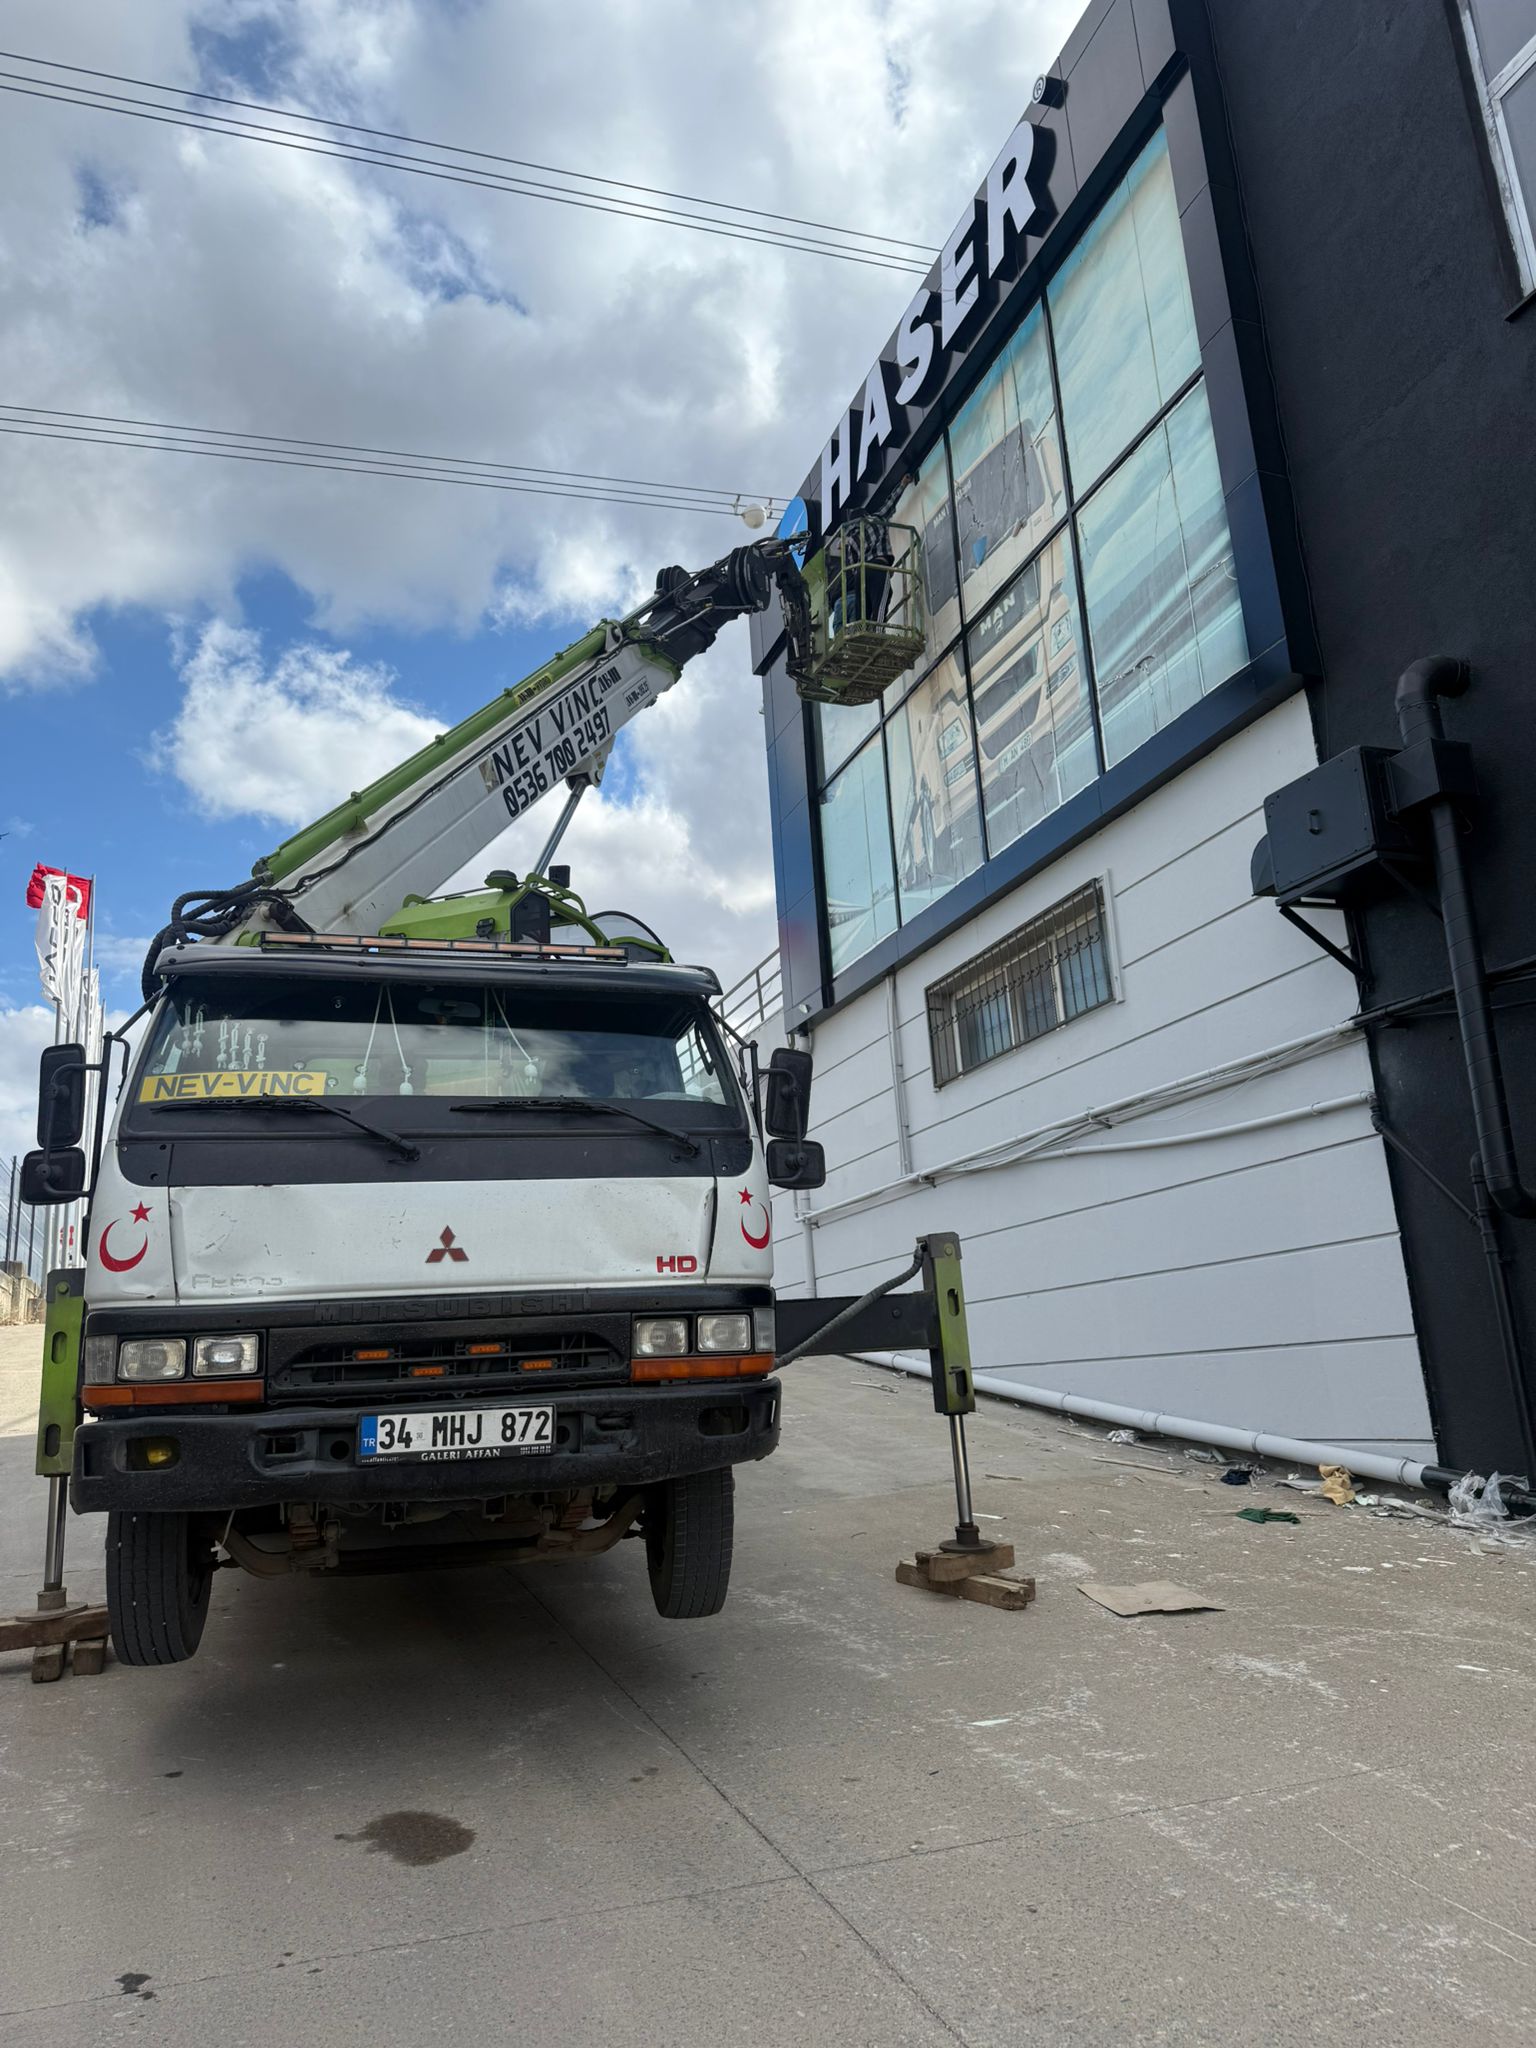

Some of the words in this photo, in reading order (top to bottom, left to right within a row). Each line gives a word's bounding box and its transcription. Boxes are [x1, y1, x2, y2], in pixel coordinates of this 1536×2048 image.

[822, 121, 1037, 536] HASER
[980, 592, 1015, 636] MAN
[492, 718, 543, 785] NEV
[502, 760, 549, 818] 0536
[544, 737, 577, 782] 700
[573, 705, 611, 757] 2497
[656, 1255, 698, 1273] HD
[314, 1292, 594, 1322] MITSUBISHI
[363, 1437, 376, 1448] TR
[379, 1417, 413, 1449] 34
[431, 1413, 483, 1447] MHJ
[501, 1410, 551, 1443] 872
[420, 1450, 461, 1462] GALERI
[466, 1448, 501, 1459] AFFAN
